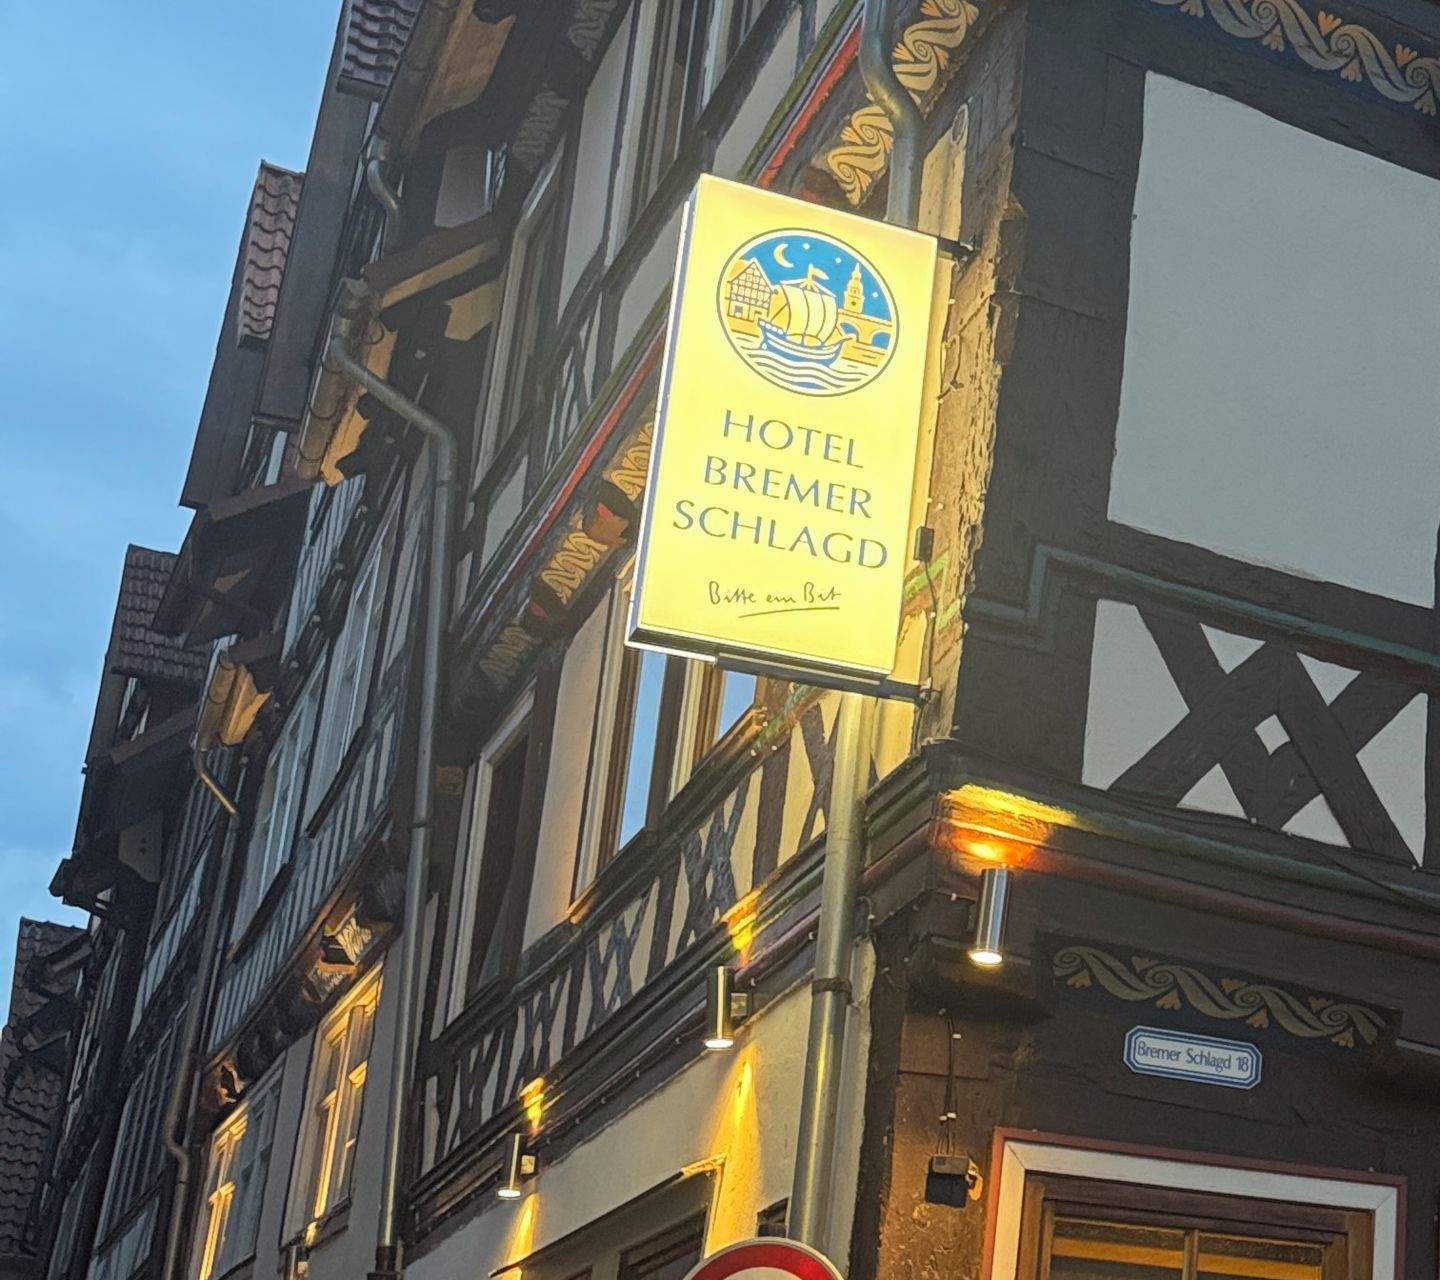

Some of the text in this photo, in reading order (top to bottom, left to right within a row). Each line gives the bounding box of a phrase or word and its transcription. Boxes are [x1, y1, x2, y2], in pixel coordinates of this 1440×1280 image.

[722, 409, 864, 469] HOTEL
[704, 455, 871, 519] BREMER
[673, 500, 888, 570] SCHLAGD
[709, 581, 756, 605] Bitte
[803, 581, 842, 604] Bit
[1136, 1040, 1250, 1072] Bremer Schlagd 18
